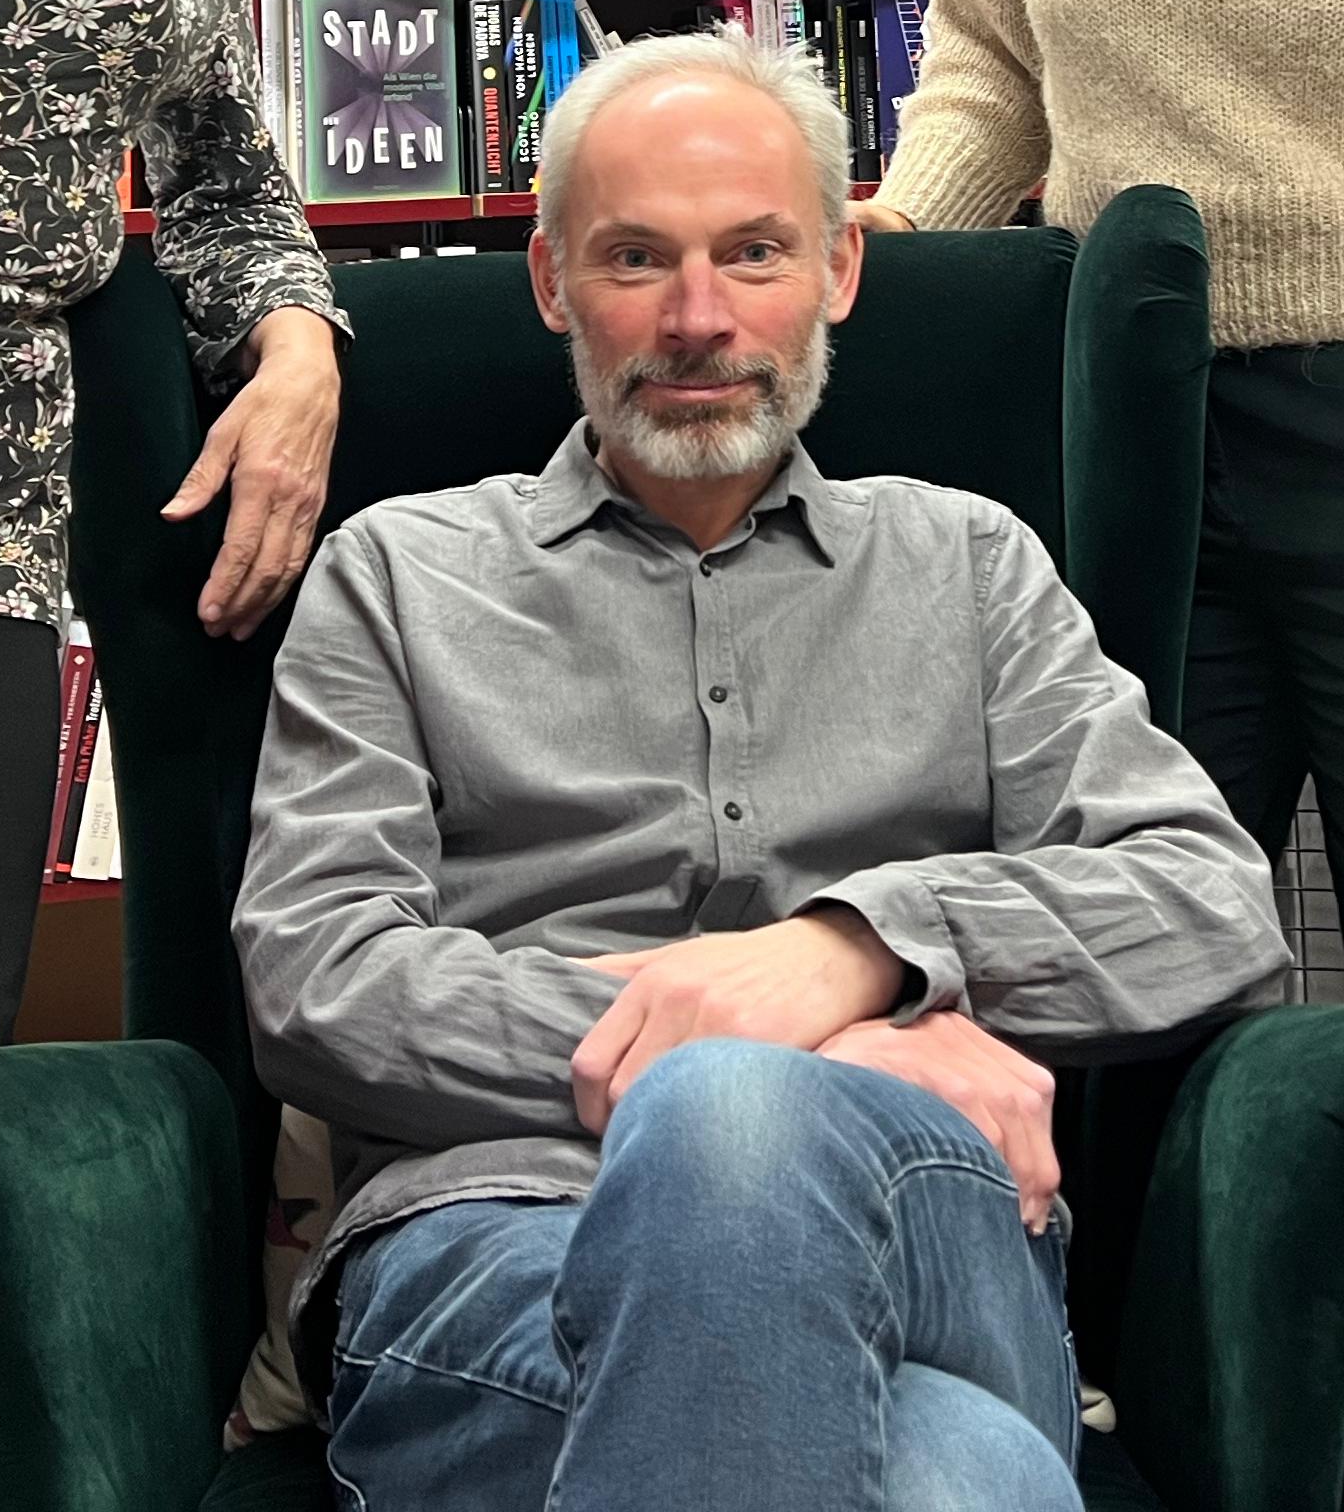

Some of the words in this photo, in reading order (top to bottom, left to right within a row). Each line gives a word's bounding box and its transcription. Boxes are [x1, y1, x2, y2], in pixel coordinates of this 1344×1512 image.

[322, 8, 439, 57] STADT
[475, 19, 490, 61] PADOVA
[486, 4, 500, 47] THOMAS
[512, 17, 524, 77] HACKERN
[525, 32, 535, 78] LERNEN
[515, 80, 526, 99] VON
[482, 87, 502, 177] QUANTENLICHT
[518, 124, 529, 163] SCOTT
[529, 111, 541, 163] SHAPIRO
